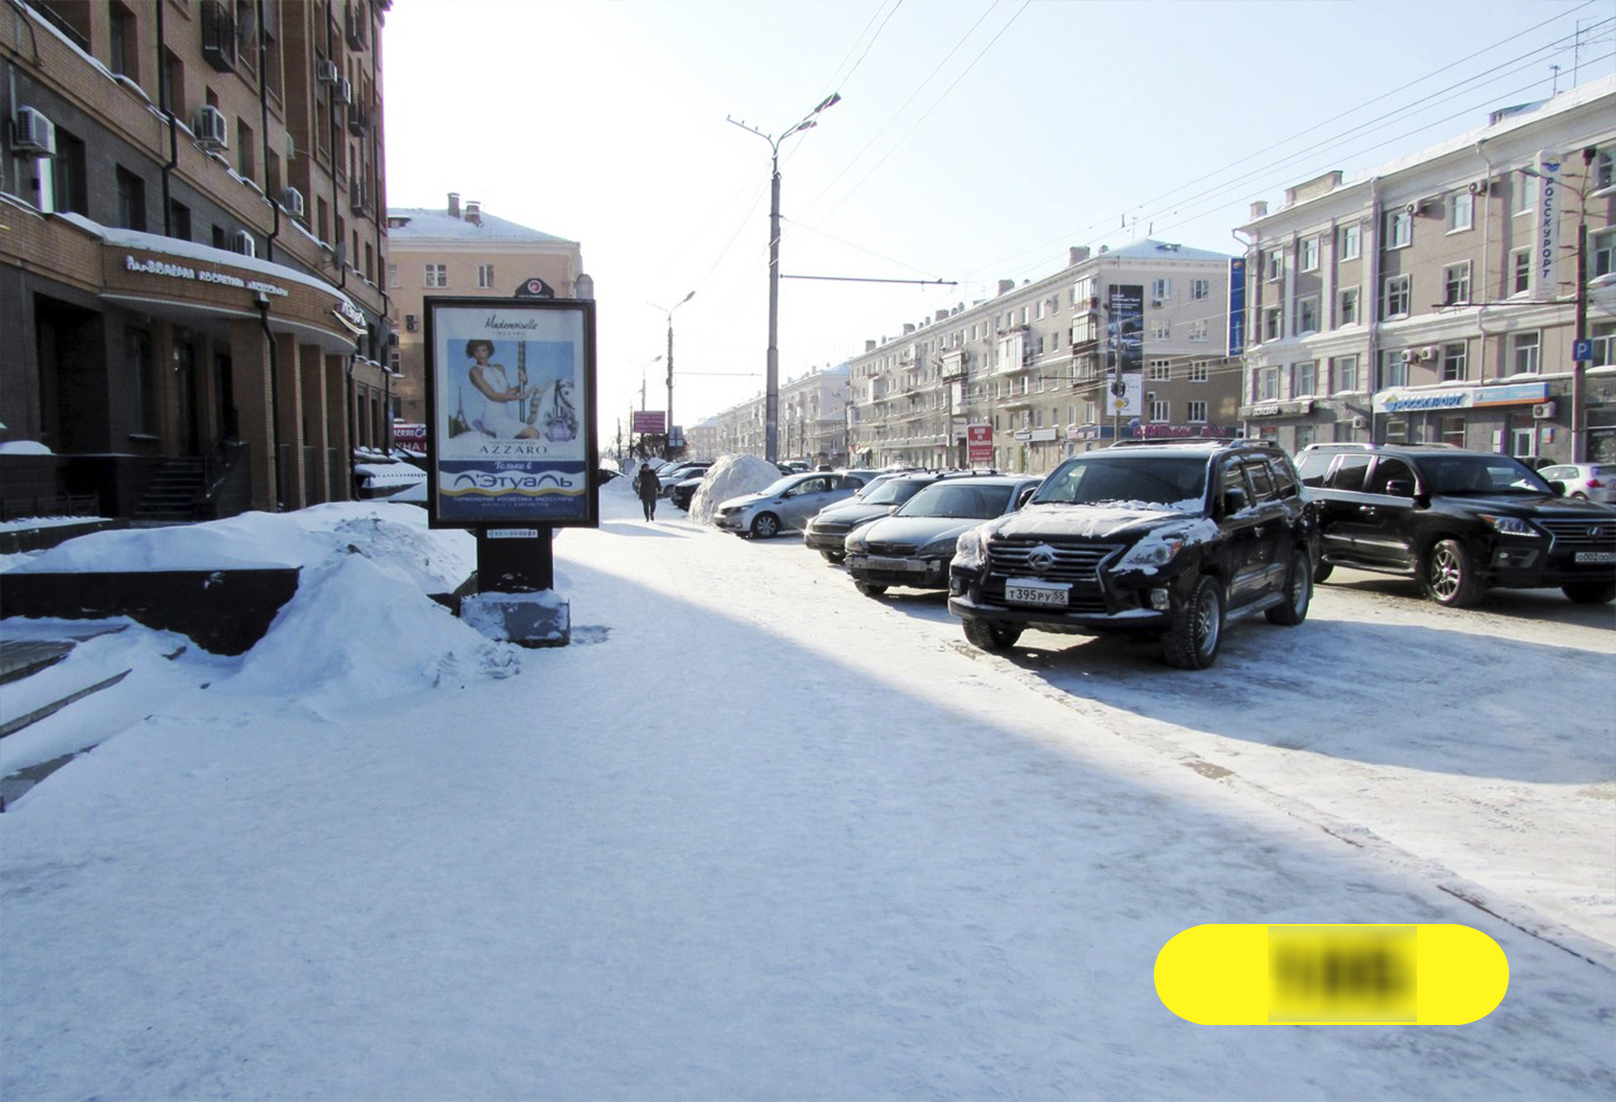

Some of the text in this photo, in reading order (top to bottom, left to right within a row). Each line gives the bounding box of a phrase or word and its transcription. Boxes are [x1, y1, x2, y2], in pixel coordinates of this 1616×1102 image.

[1542, 177, 1555, 279] РОССКУРОРТ
[484, 314, 538, 330] Mademoiselle
[480, 445, 548, 455] AZZARO
[495, 460, 525, 470] Только
